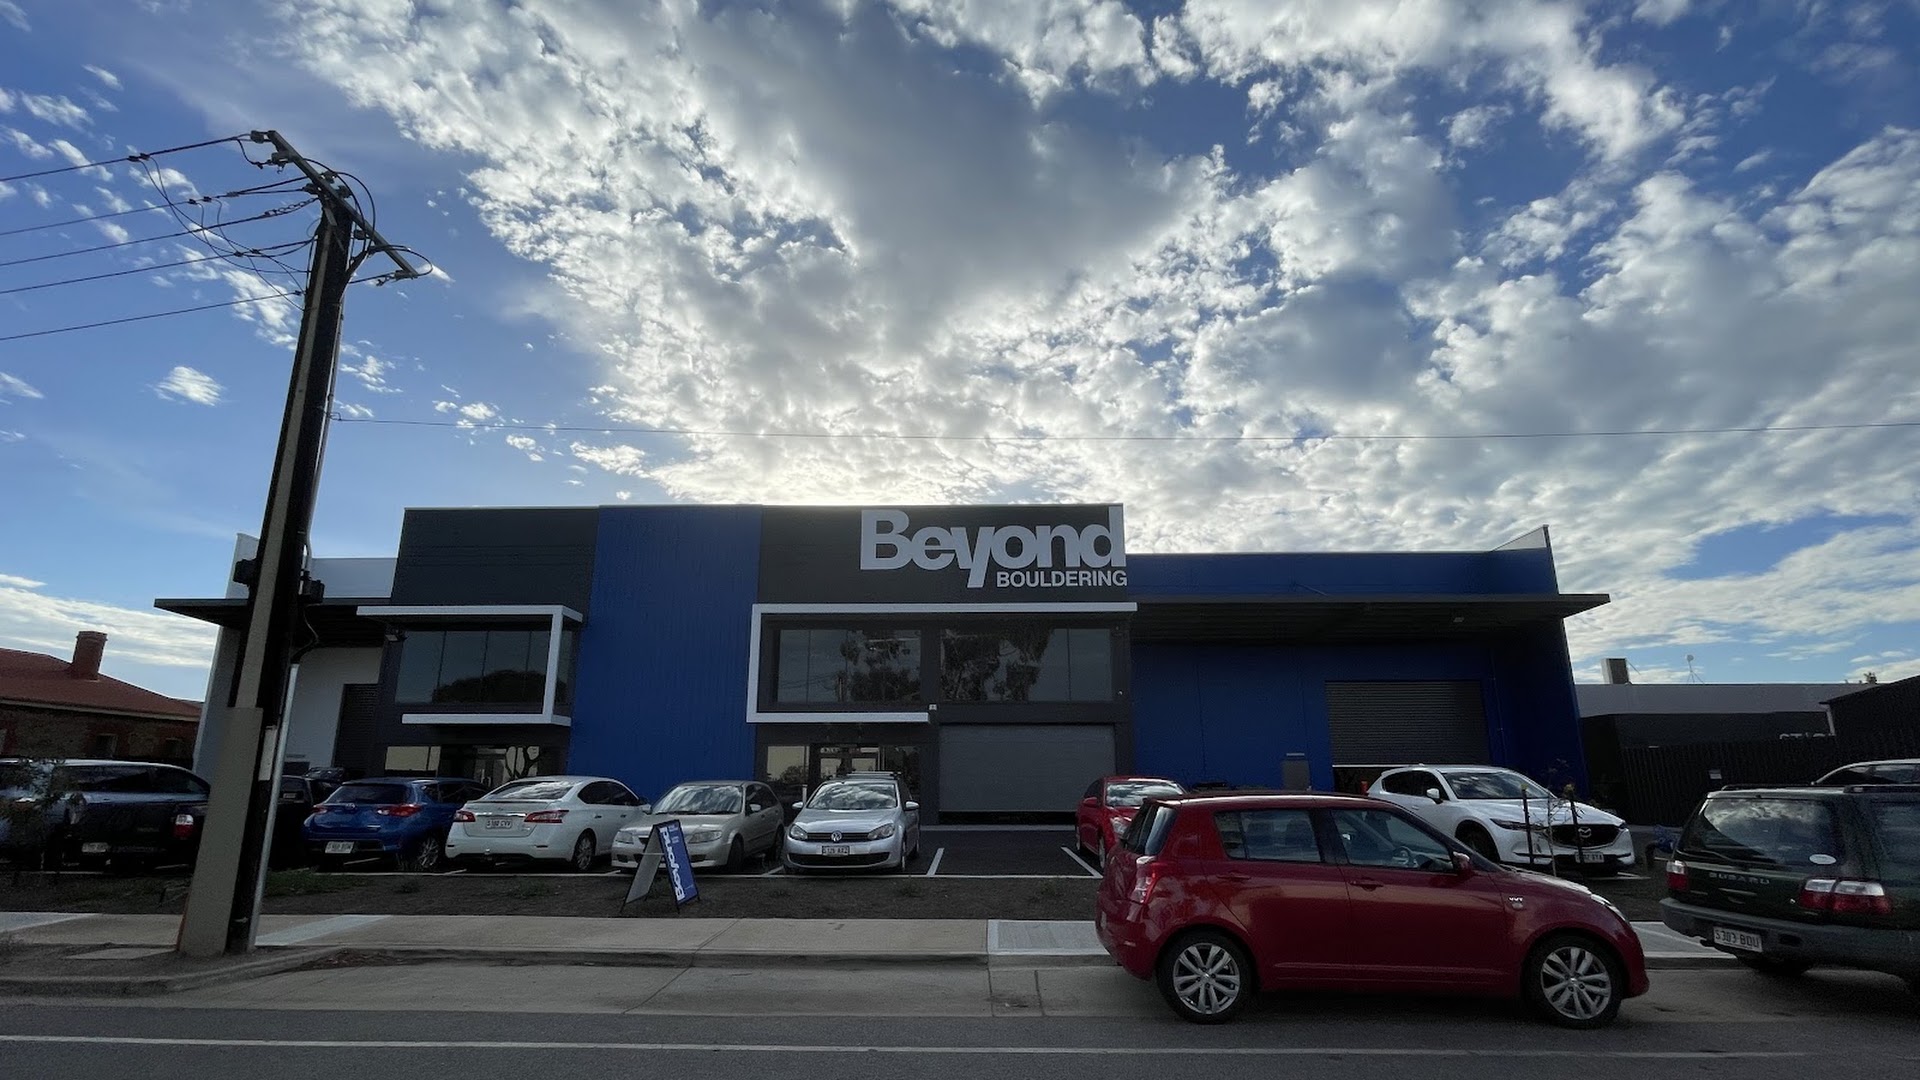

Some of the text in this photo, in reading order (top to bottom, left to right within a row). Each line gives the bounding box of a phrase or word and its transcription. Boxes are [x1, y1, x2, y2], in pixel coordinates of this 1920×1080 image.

[860, 506, 1127, 588] Beyond
[996, 570, 1128, 588] BOULDERING
[659, 826, 686, 901] Beyond
[1709, 872, 1770, 885] SUBARU
